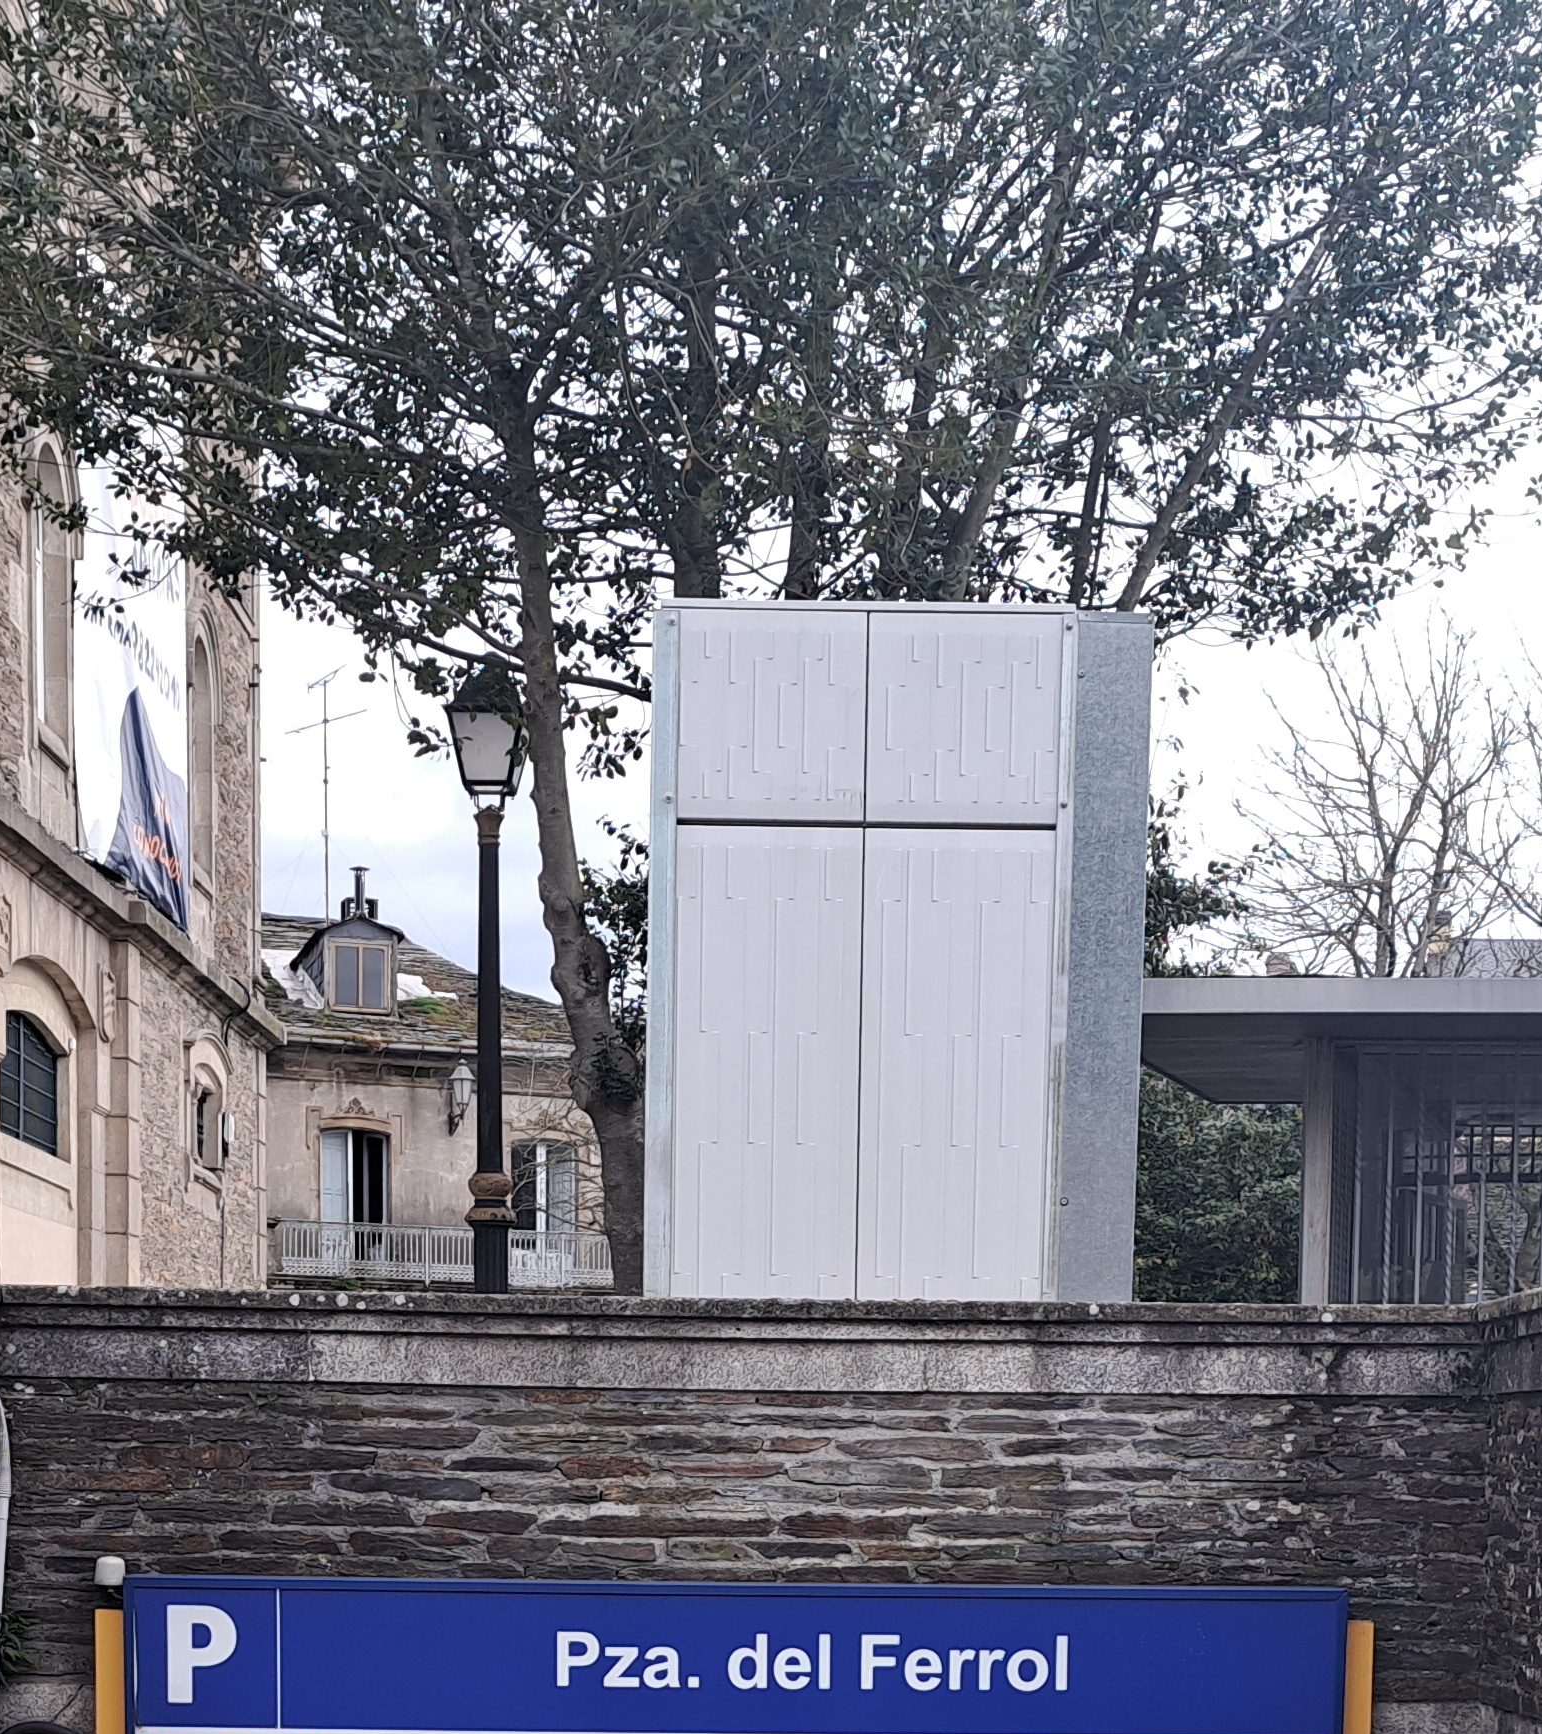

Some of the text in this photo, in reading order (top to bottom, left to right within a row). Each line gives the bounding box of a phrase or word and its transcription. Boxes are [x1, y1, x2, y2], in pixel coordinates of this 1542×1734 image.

[166, 1604, 237, 1703] P
[555, 1630, 1070, 1692] Pza. del Ferrol
